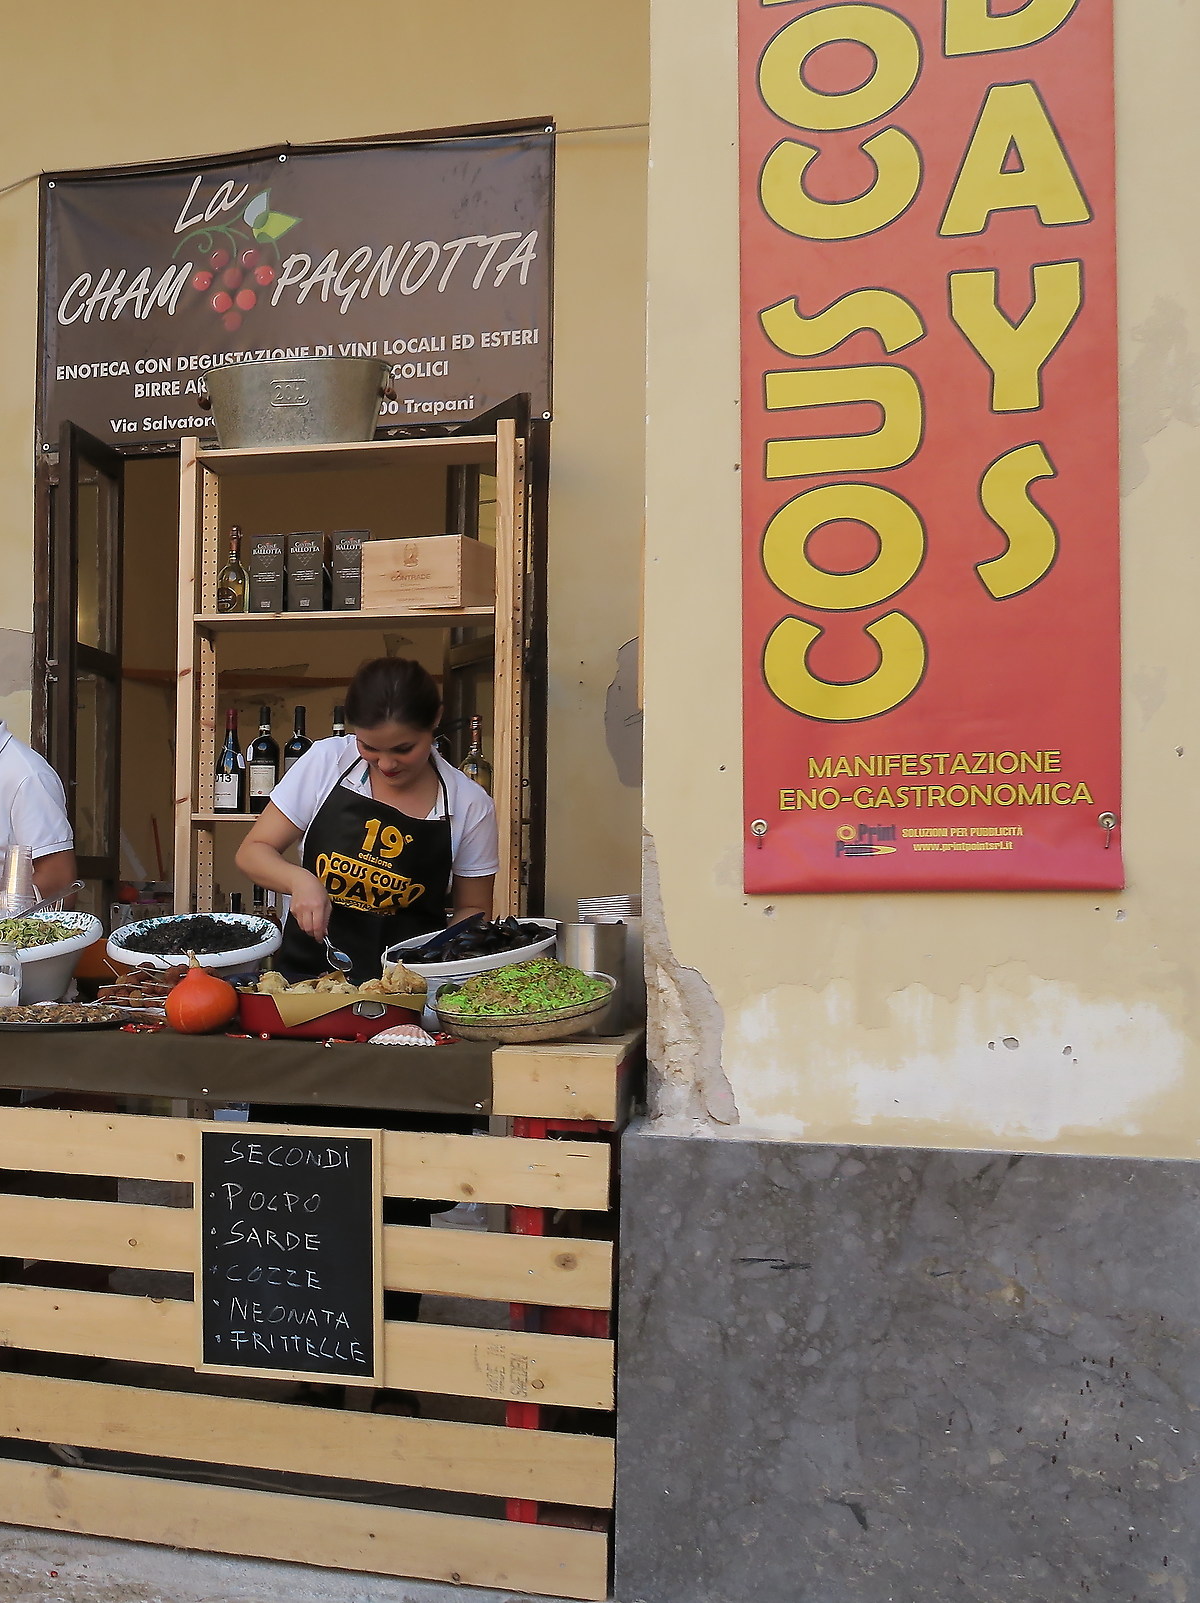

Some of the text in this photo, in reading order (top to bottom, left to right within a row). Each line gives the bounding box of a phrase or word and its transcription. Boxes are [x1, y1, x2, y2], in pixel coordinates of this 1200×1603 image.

[173, 175, 248, 234] La
[56, 230, 539, 326] CHAM PAGNOTTA
[56, 328, 539, 381] ENOTECA CON DEGUSTAZIONE DI VINI LOCALI ED ESTERI
[134, 381, 180, 398] BIRRE
[392, 360, 449, 380] COLICI
[110, 419, 138, 433] Via
[404, 395, 475, 416] Trapani
[761, 286, 927, 723] COUS
[808, 750, 1062, 779] MANIFESTAZIONE
[778, 782, 1095, 811] ENO-GASTRONOMICA
[901, 827, 949, 838] SOLUZIONI
[950, 827, 968, 837] PER
[330, 857, 409, 892] COUS COUS
[358, 852, 393, 869] edizione
[325, 872, 405, 908] DAYS
[223, 1140, 350, 1169] SECONDI
[221, 1182, 321, 1213] POLPO
[222, 1220, 321, 1252] SARDE
[225, 1264, 322, 1290] COZZE
[230, 1297, 350, 1330] NEONATA
[230, 1331, 367, 1364] FRITTELLE
